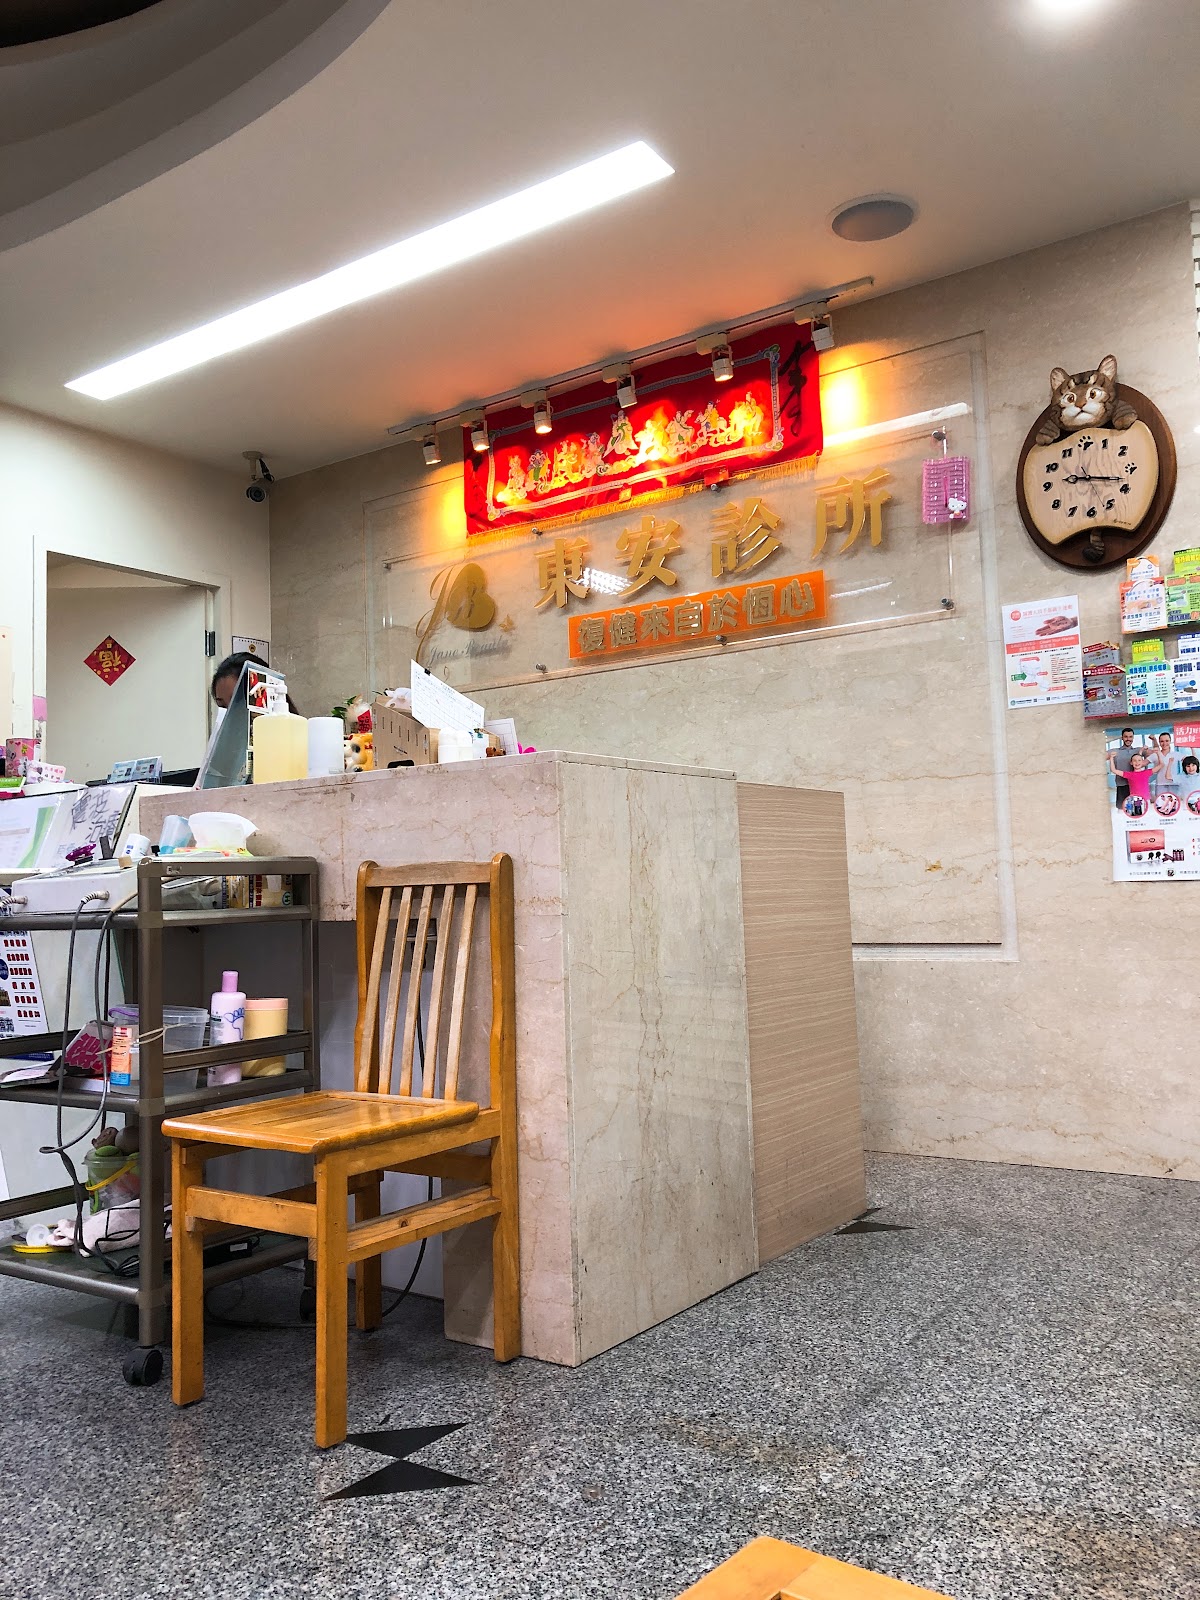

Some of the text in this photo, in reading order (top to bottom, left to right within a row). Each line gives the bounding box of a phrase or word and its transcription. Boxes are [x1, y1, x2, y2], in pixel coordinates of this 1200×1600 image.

[1102, 438, 1108, 449] 1
[1062, 447, 1073, 459] 11
[1118, 446, 1128, 457] 2
[1045, 462, 1059, 473] 10
[1043, 481, 1053, 492] 9
[1119, 483, 1131, 494] 4
[1051, 499, 1061, 510] 8
[1105, 499, 1115, 510] 5
[1068, 505, 1078, 517] 7
[1086, 506, 1097, 518] 6
[534, 466, 892, 609] 東安診所
[427, 647, 459, 667] Jane
